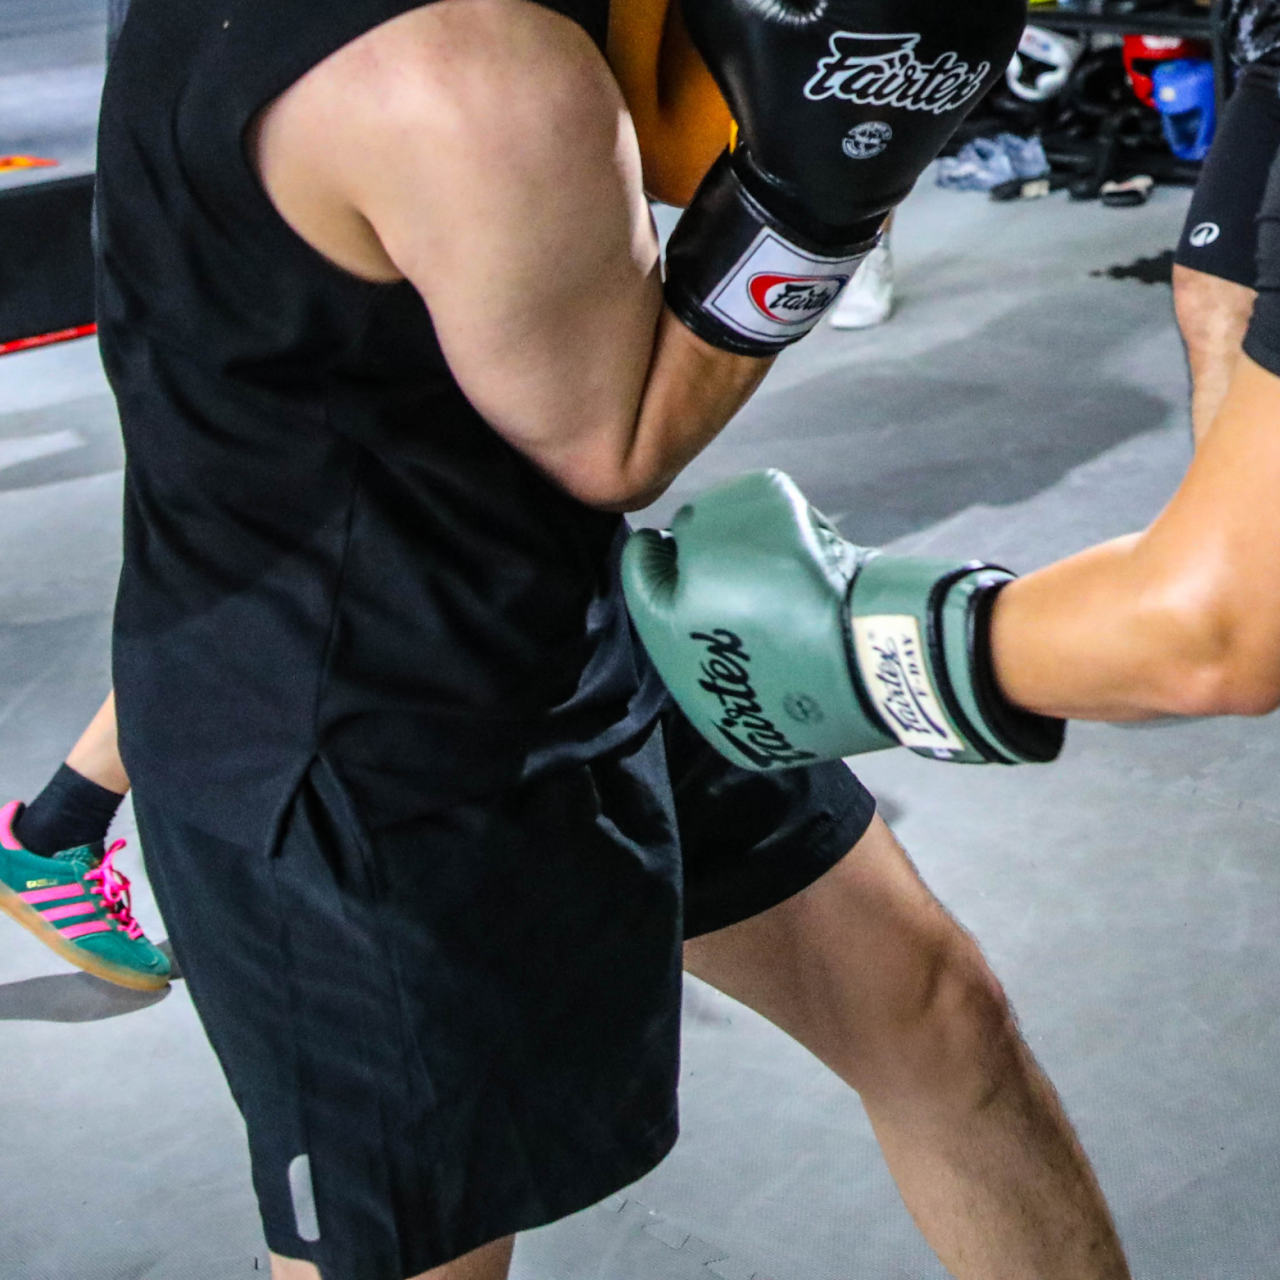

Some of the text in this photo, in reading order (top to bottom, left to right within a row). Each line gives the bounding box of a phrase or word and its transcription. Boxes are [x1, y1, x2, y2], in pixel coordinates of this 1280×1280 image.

[803, 30, 990, 114] Fairtex
[769, 283, 834, 311] Fairt
[690, 628, 818, 768] Fairtex
[872, 636, 932, 734] Fairtex
